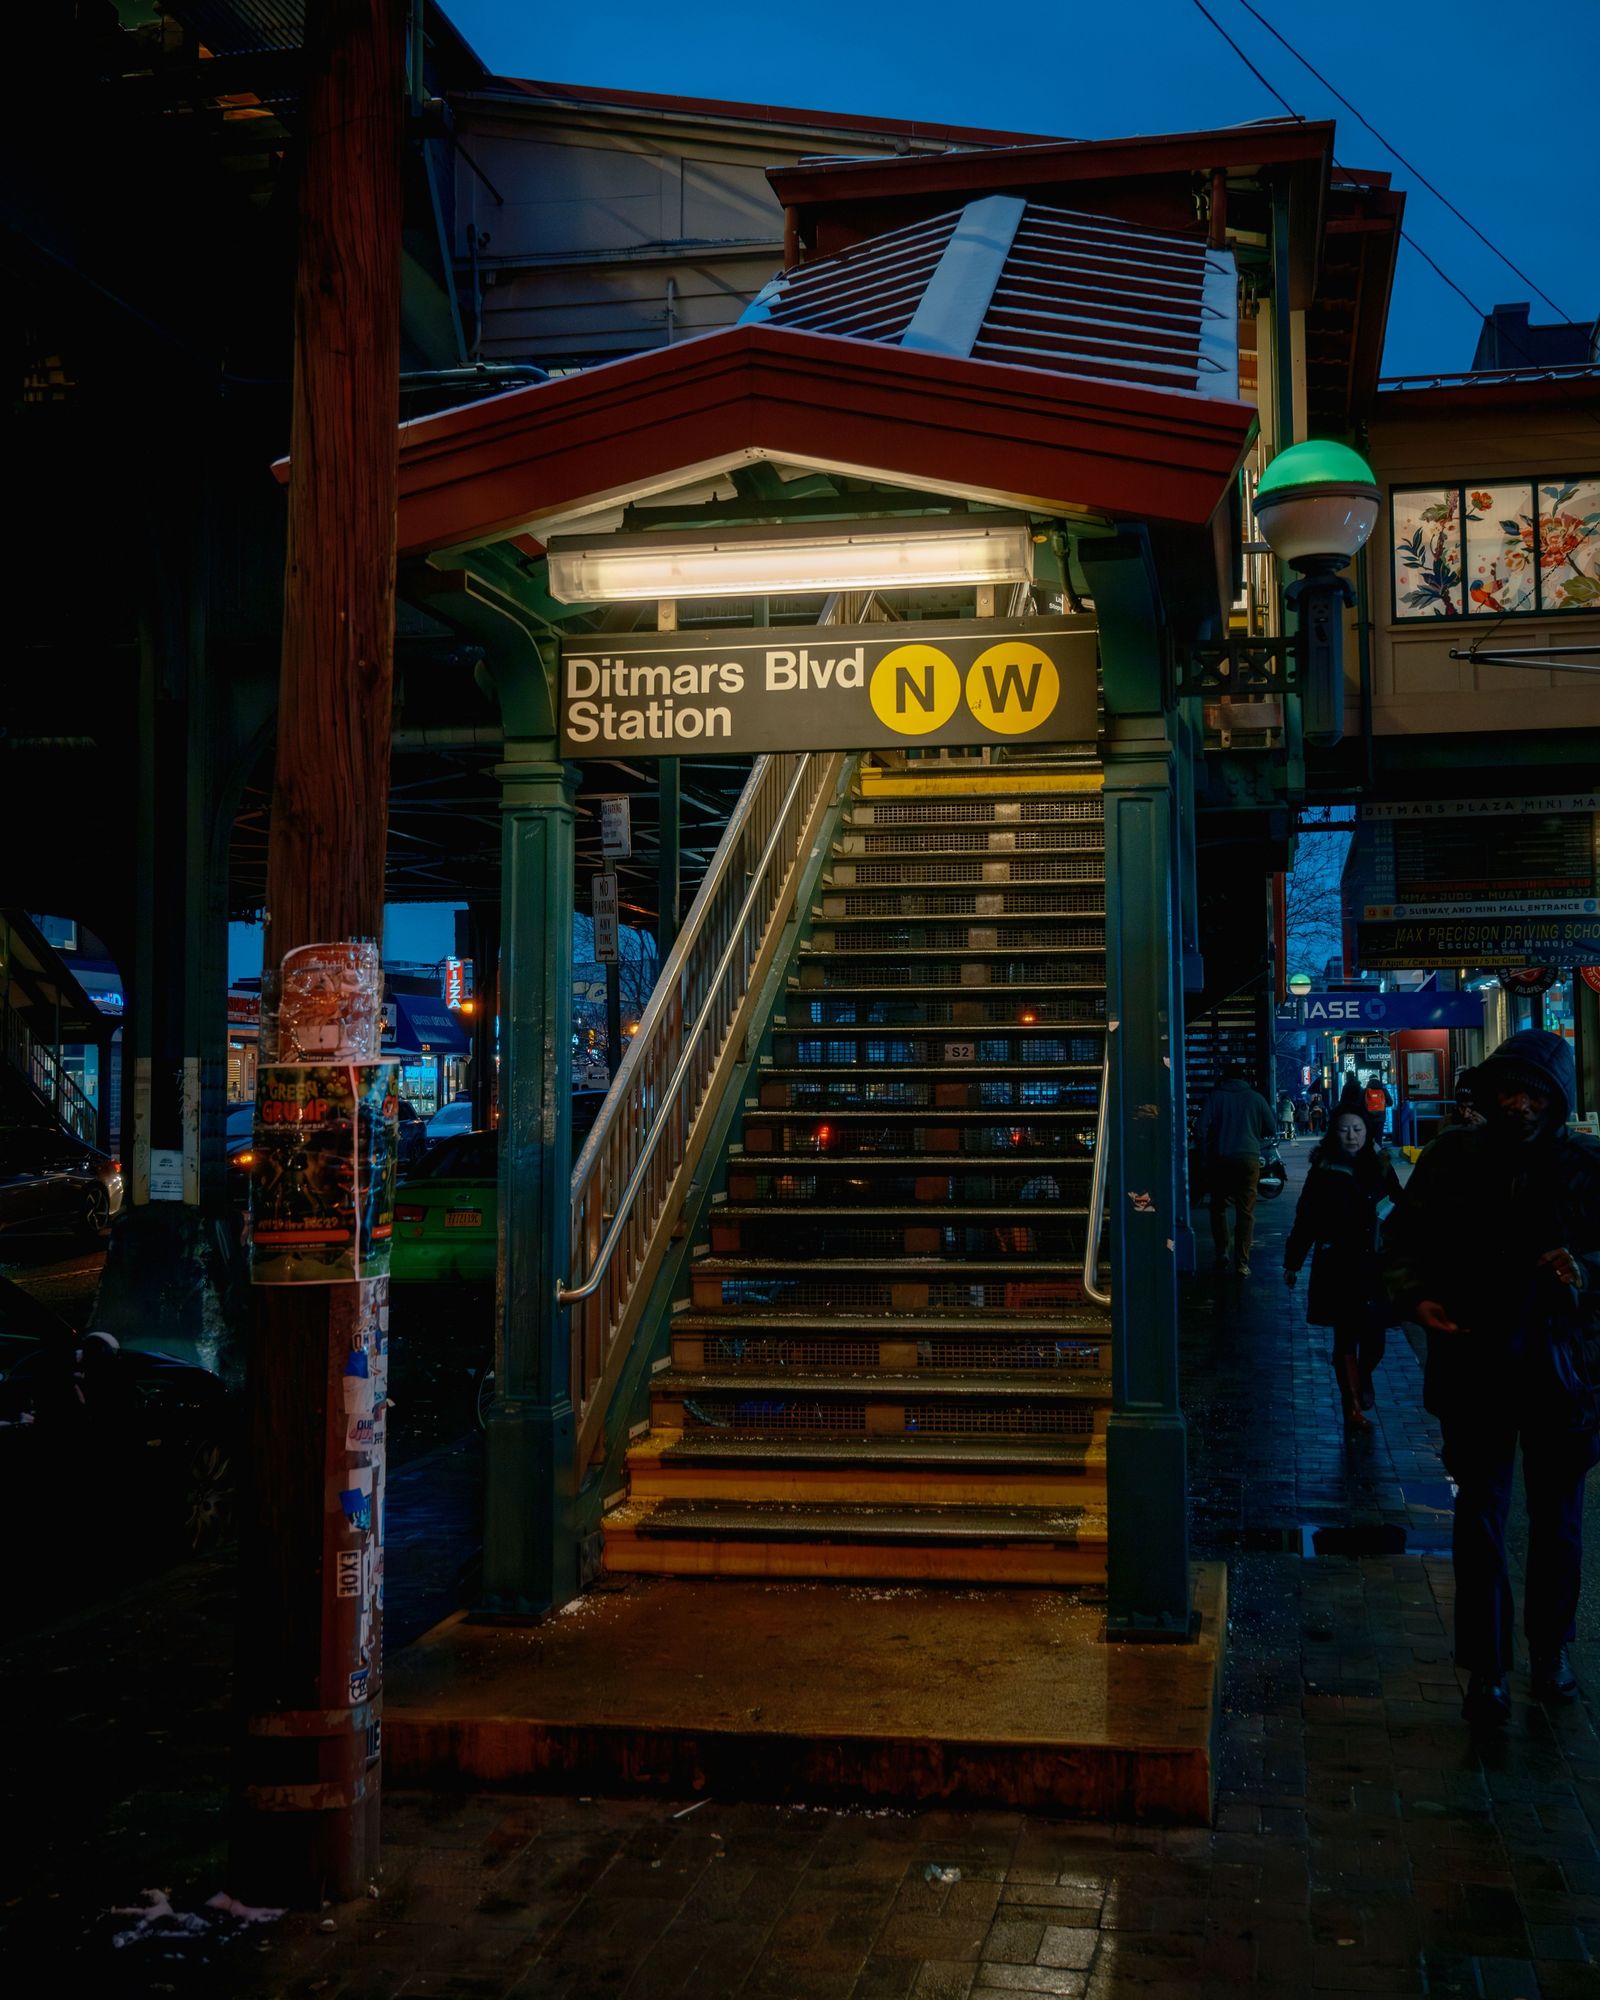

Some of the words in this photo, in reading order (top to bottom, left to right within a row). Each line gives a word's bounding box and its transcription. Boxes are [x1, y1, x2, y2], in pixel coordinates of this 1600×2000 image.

[567, 658, 745, 699] Ditmars
[765, 647, 865, 691] Blvd
[895, 665, 935, 714] N
[981, 662, 1043, 714] W
[567, 699, 732, 743] Station
[1365, 804, 1446, 816] DITMARS
[1456, 801, 1514, 812] PLAZA
[1524, 799, 1562, 809] MINI
[600, 880, 609, 897] NO
[1409, 907, 1450, 915] SUBWAY
[1452, 906, 1473, 914] AND
[1475, 905, 1497, 913] MINI
[1500, 904, 1525, 912] MALL
[1527, 903, 1580, 911] ENTRANCE
[600, 918, 611, 931] ANY
[1395, 927, 1424, 945] MAX
[1427, 925, 1500, 943] PRECISION
[1504, 924, 1560, 940] DRIVING
[1437, 941, 1493, 950] Escuela
[1501, 940, 1517, 949] de
[1524, 939, 1574, 949] Manejo
[448, 960, 463, 1009] PIZZA
[269, 1081, 319, 1101] GREEN
